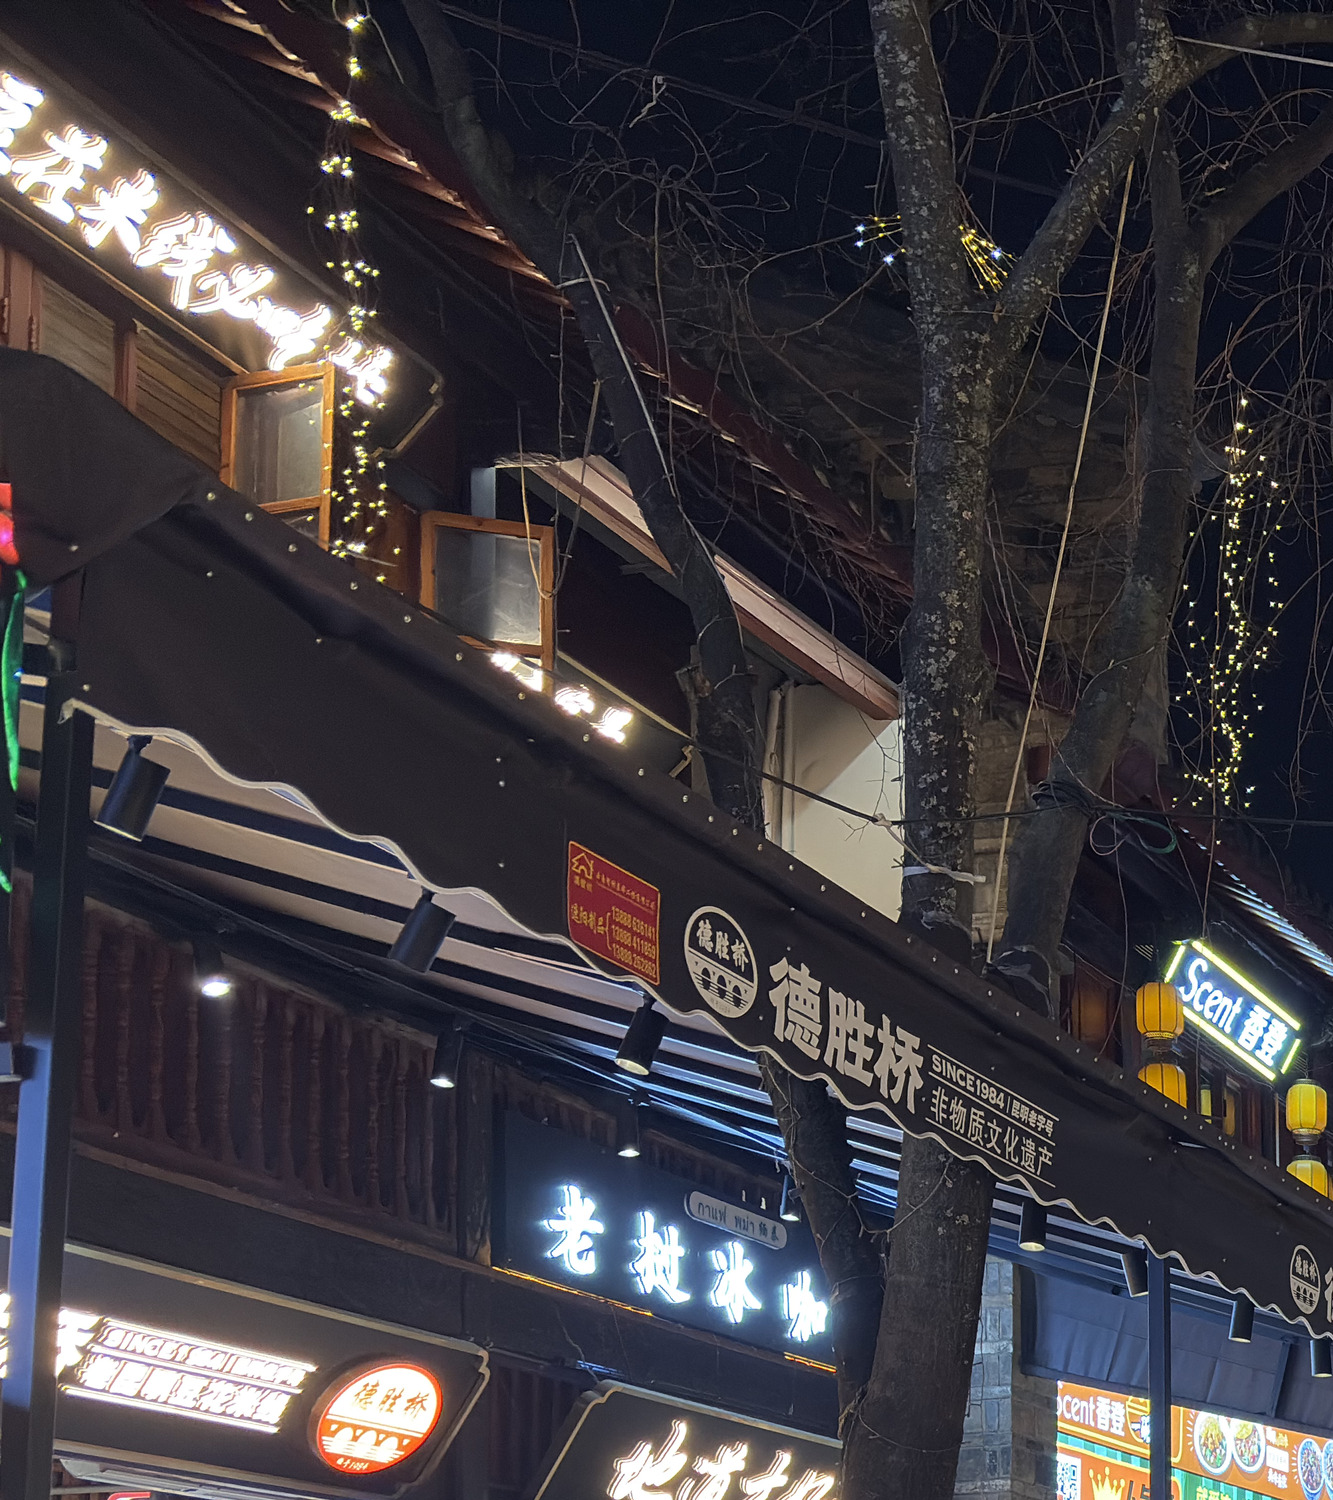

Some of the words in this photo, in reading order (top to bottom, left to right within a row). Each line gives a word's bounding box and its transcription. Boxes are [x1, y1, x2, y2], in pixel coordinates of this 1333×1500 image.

[696, 919, 749, 972] 德胜桥
[769, 957, 924, 1114] 德胜桥
[1178, 957, 1244, 1034] Scent
[1238, 1004, 1289, 1066] 香登
[931, 1086, 1053, 1175] 非物质文化遗产
[932, 1054, 1005, 1108] SINCE1984
[1011, 1102, 1055, 1137] 昆明老字号
[353, 1380, 429, 1420] 德胜桥
